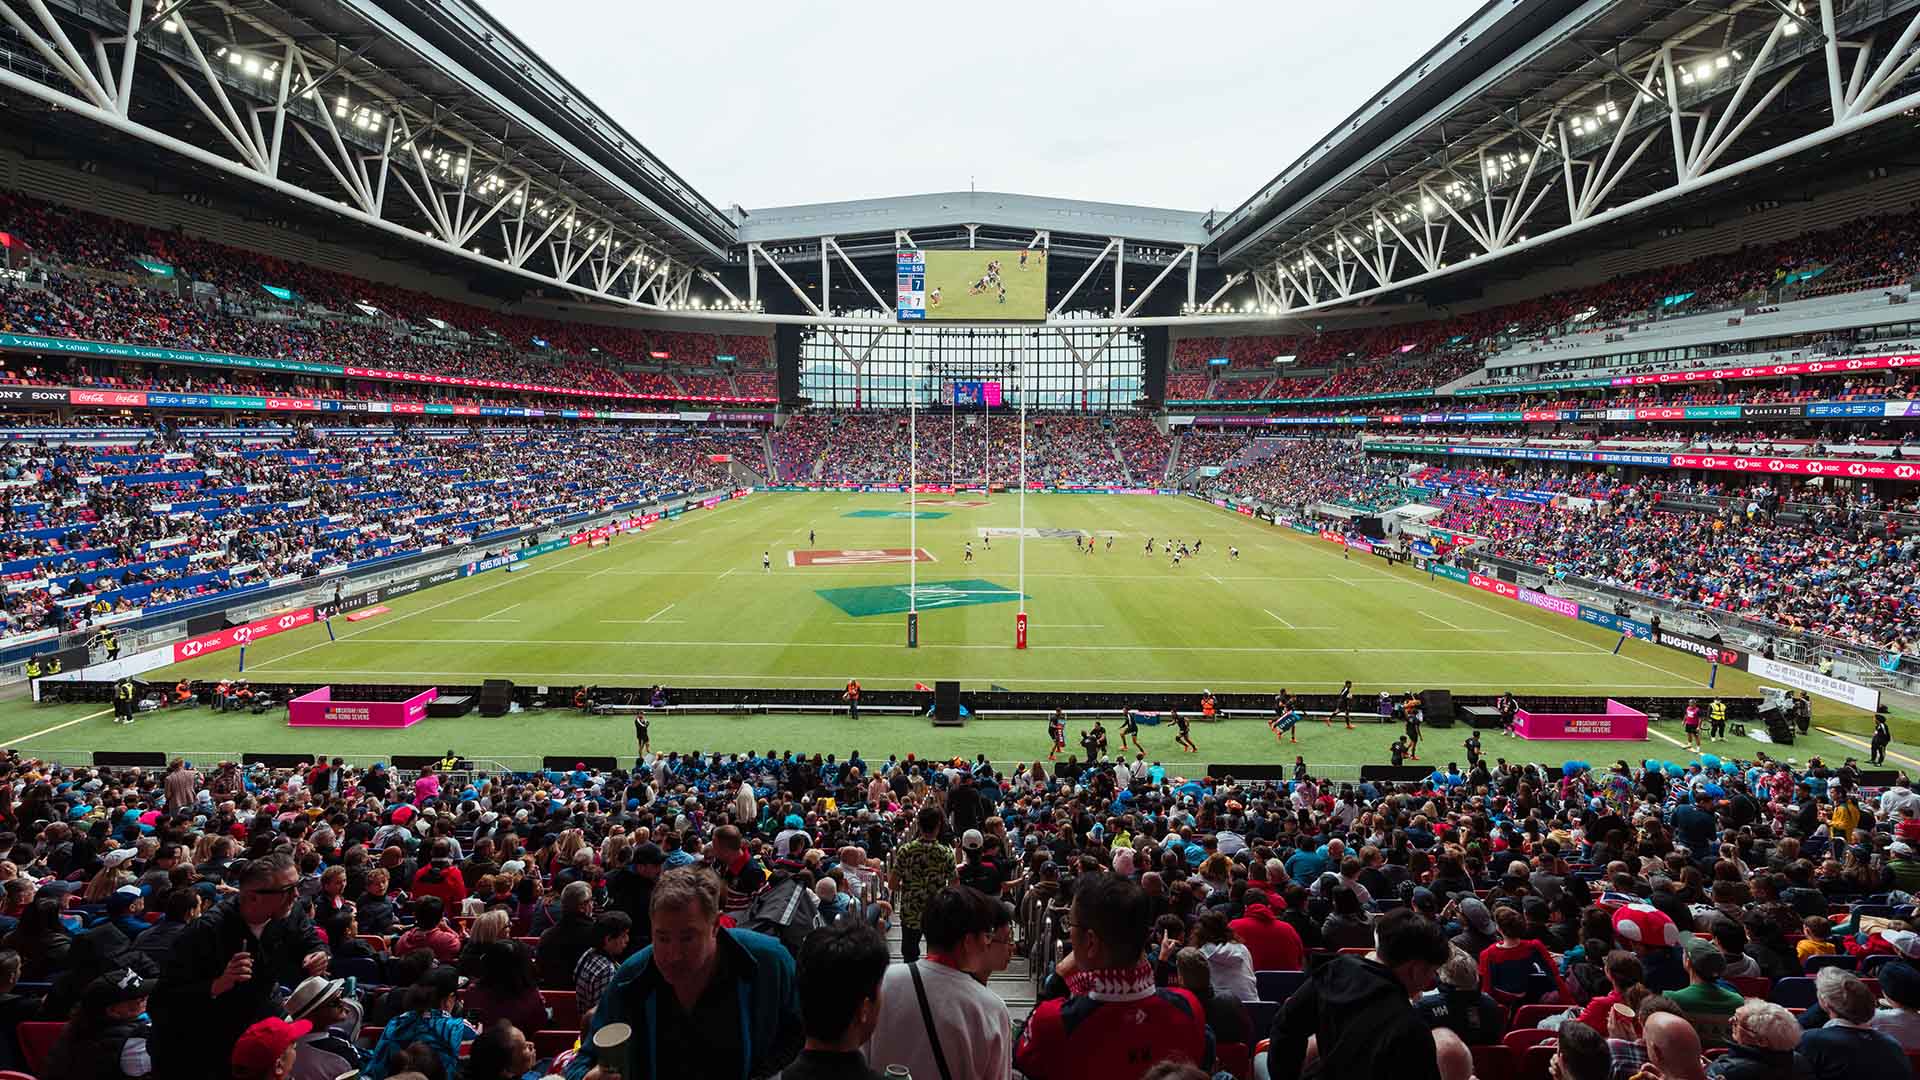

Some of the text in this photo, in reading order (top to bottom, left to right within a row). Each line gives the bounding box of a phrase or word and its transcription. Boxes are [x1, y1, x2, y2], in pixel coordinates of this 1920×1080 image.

[23, 340, 49, 348] CATHAY
[66, 344, 90, 352] CATHAY
[32, 392, 66, 400] SONY
[204, 613, 310, 648] HSBC HSBC HSBC
[1661, 633, 1738, 665] RUGBYPASS TV
